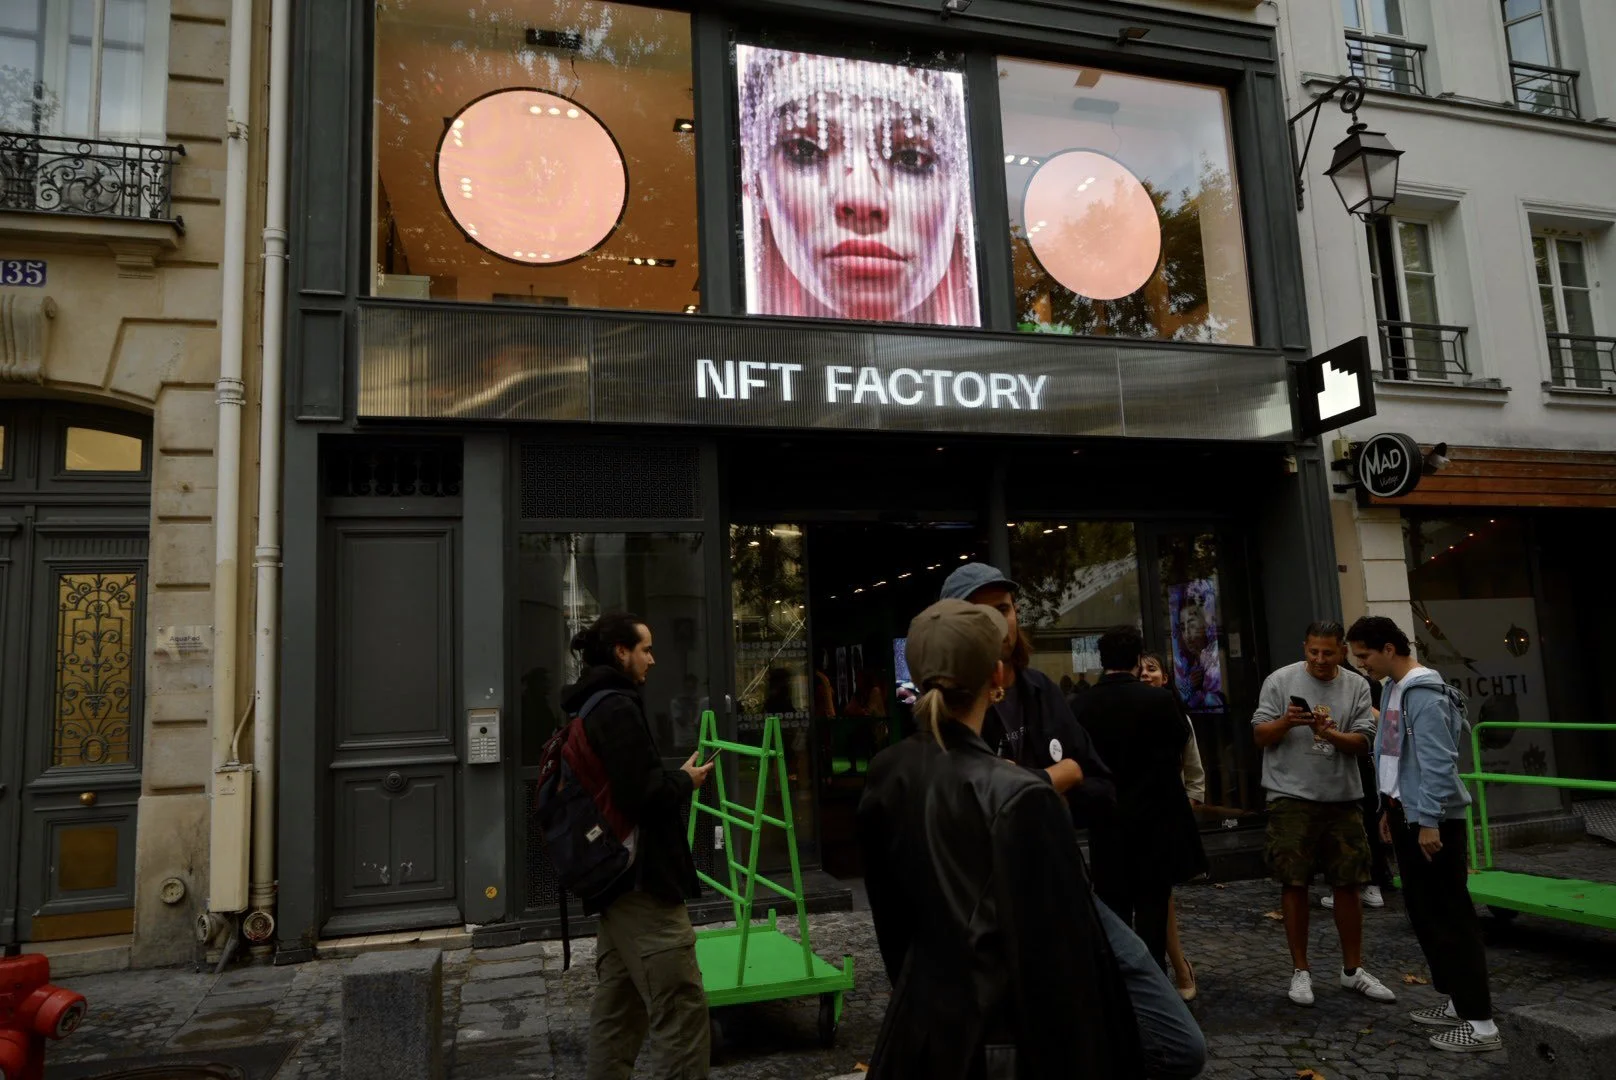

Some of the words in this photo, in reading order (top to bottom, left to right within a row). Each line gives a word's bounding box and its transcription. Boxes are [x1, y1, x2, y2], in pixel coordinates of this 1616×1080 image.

[696, 359, 802, 401] NFT
[826, 365, 1047, 410] FACTORY
[1365, 441, 1401, 490] MAD
[1451, 675, 1527, 697] RICHTI
